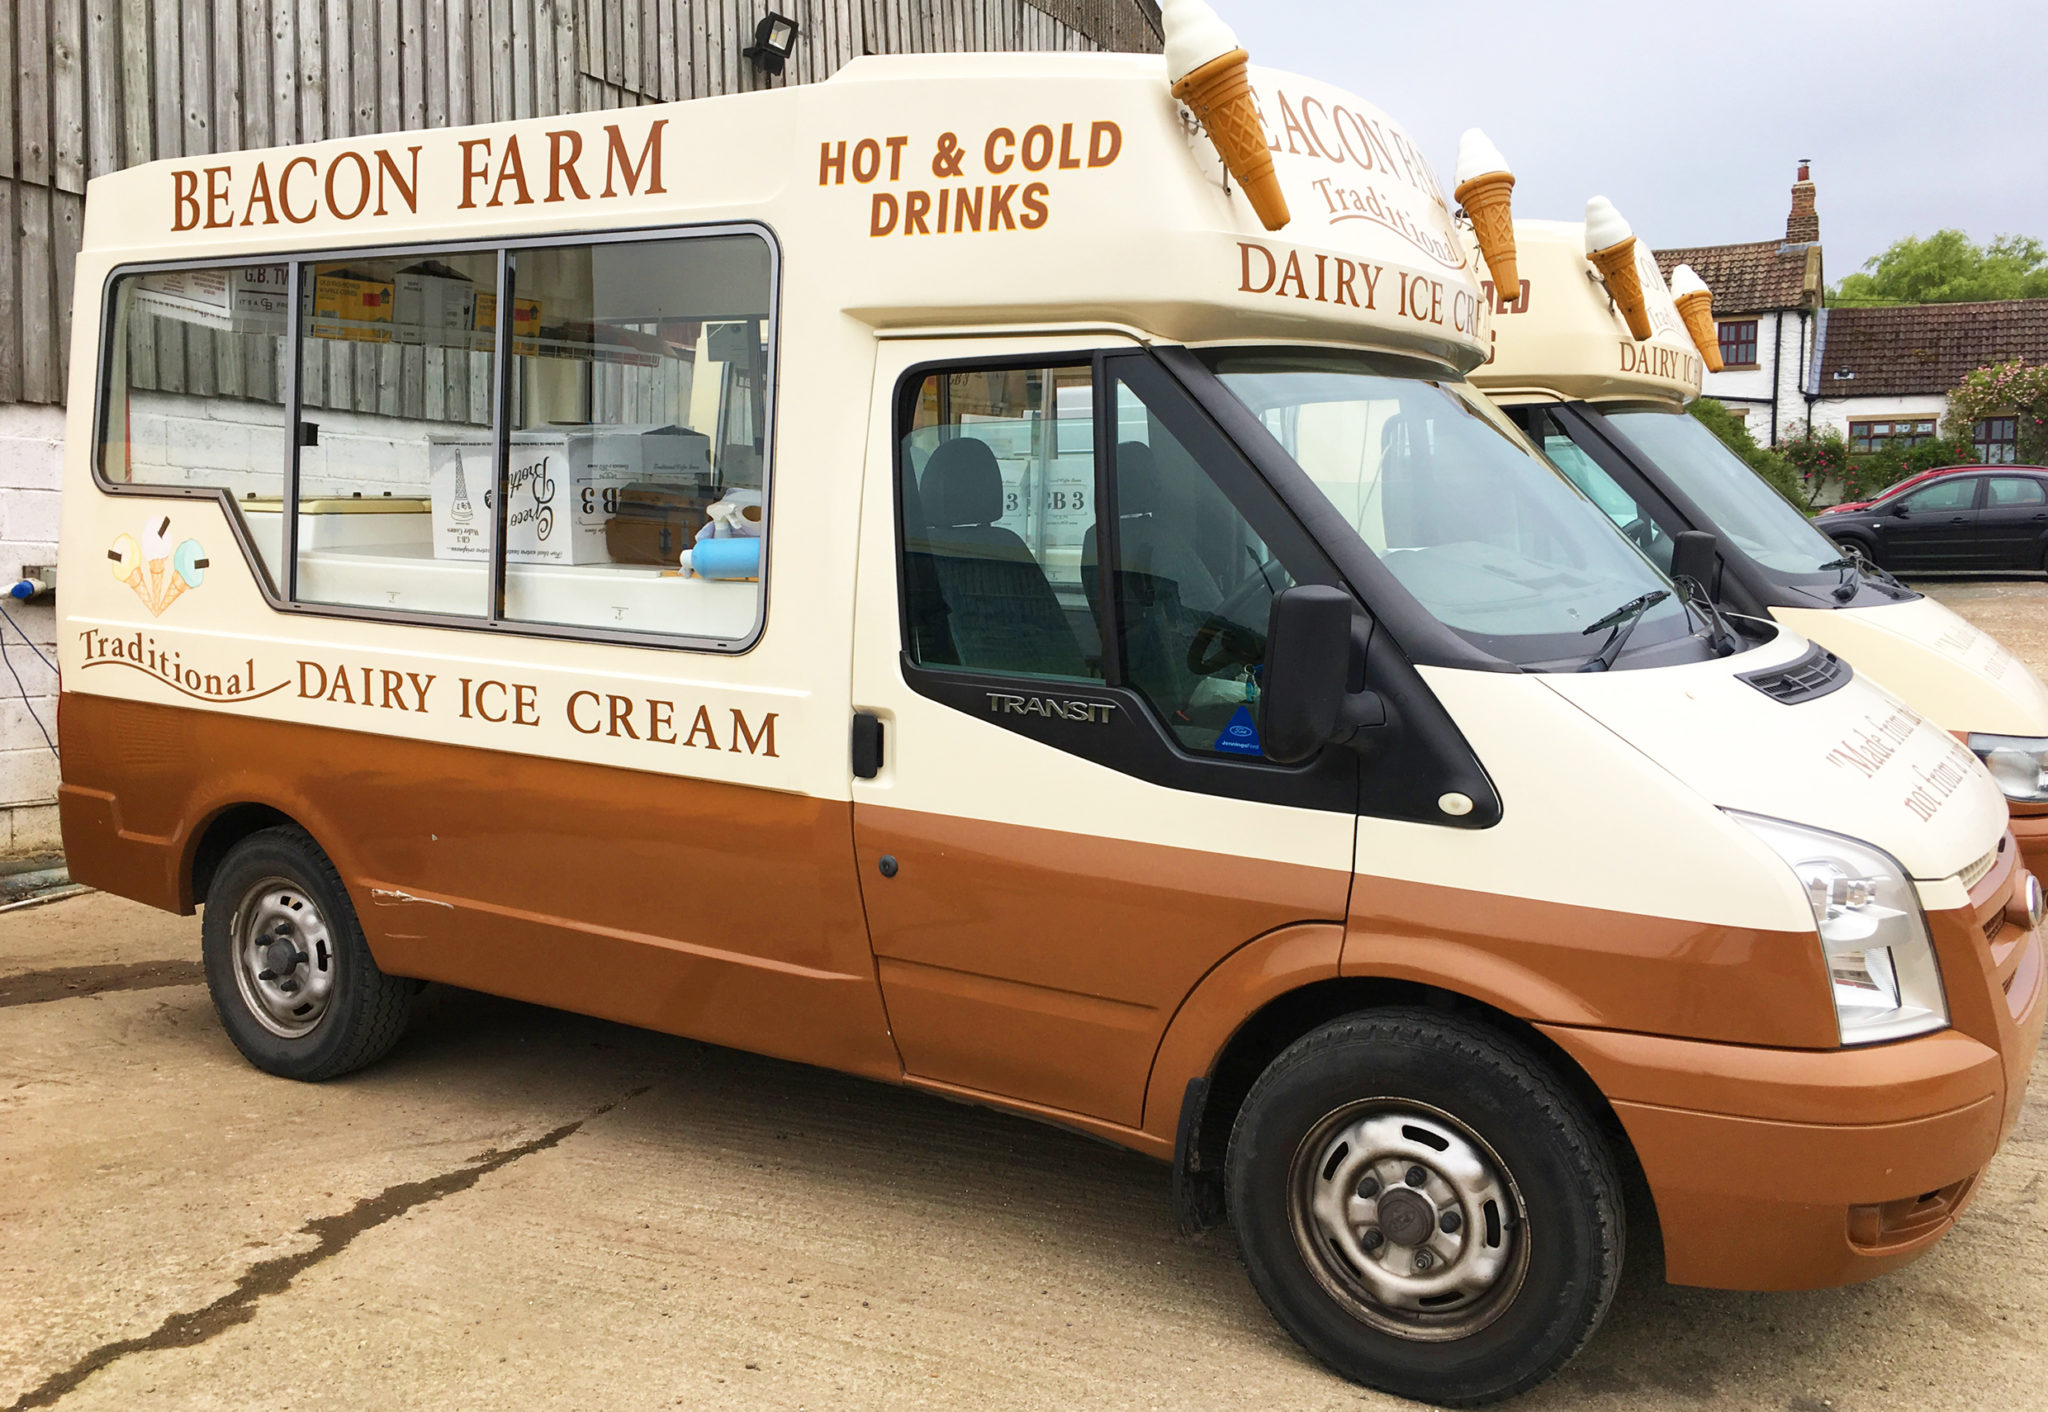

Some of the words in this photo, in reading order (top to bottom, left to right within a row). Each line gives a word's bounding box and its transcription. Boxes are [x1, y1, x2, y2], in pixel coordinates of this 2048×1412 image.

[819, 135, 908, 186] HOT
[931, 131, 966, 178] &
[984, 120, 1122, 174] COLD
[1248, 85, 1402, 181] EACON
[170, 144, 423, 233] BEACON
[457, 119, 669, 211] FARM
[870, 182, 1050, 237] DRINKS
[1312, 177, 1459, 263] Traditional
[1237, 242, 1384, 311] DAIRY
[1398, 271, 1443, 326] ICE
[1619, 342, 1679, 380] DAIRY
[581, 487, 595, 514] 3
[1006, 492, 1019, 511] 3
[1072, 491, 1085, 511] 3
[79, 628, 256, 698] Traditional
[296, 661, 437, 713] DAIRY
[458, 678, 541, 727] ICE
[565, 690, 780, 758] CREAM
[986, 692, 1116, 724] TRANSIT
[1904, 782, 1943, 823] not
[1912, 762, 1963, 799] from
